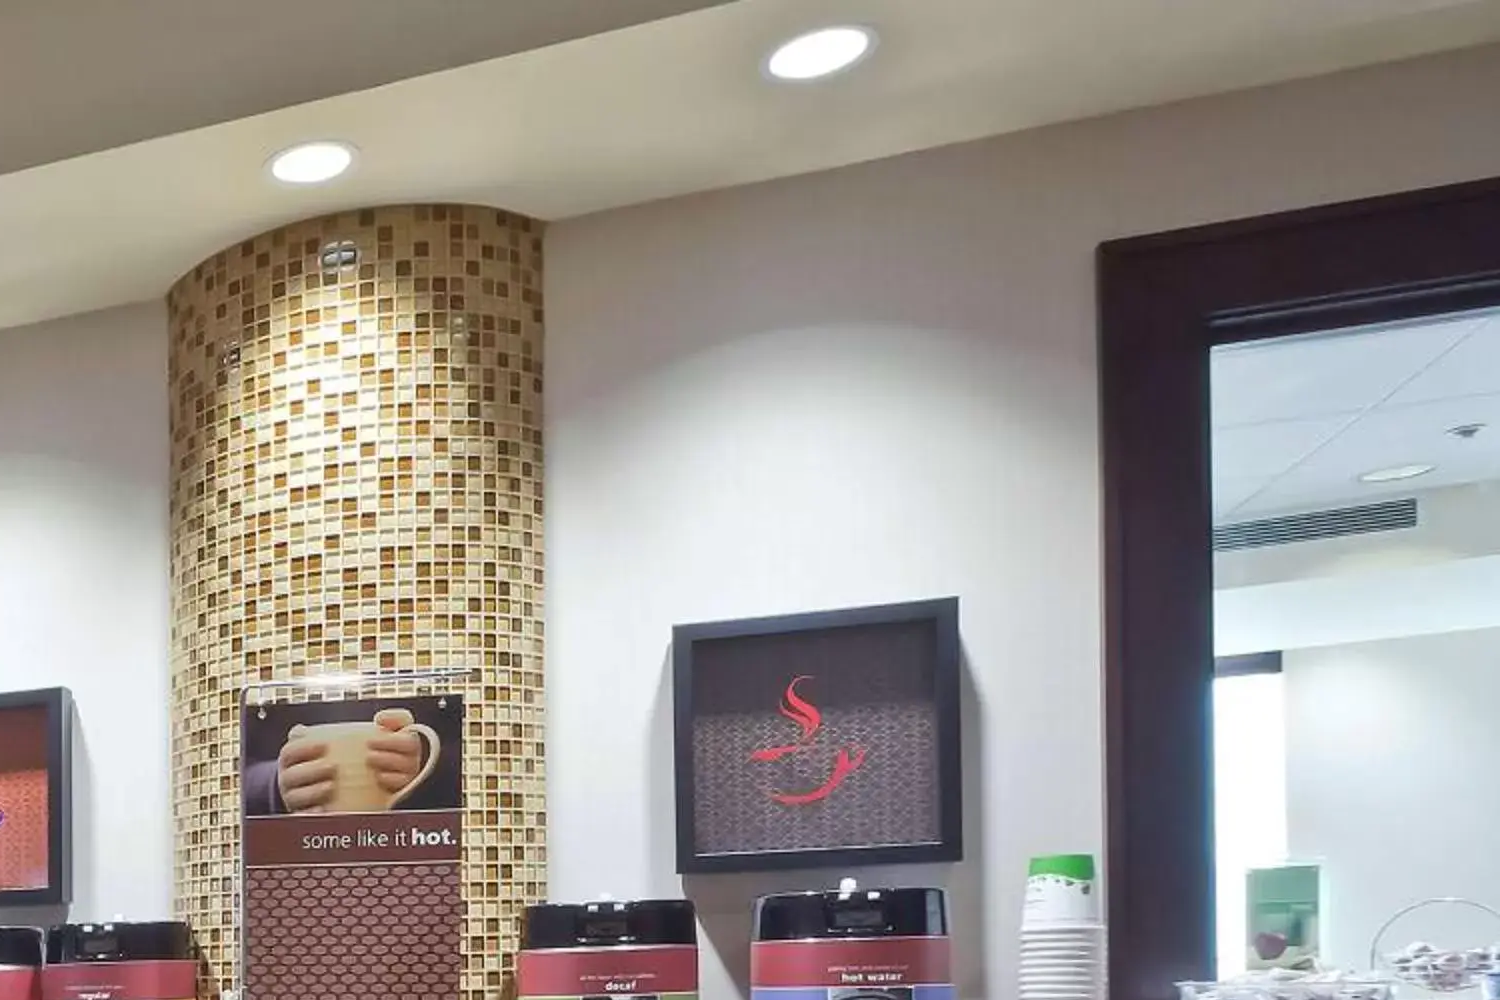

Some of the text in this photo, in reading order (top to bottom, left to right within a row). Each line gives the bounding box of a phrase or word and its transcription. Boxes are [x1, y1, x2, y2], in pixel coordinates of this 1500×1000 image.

[301, 827, 457, 849] some like it hot.
[841, 972, 904, 983] hot water
[604, 980, 637, 991] decaf
